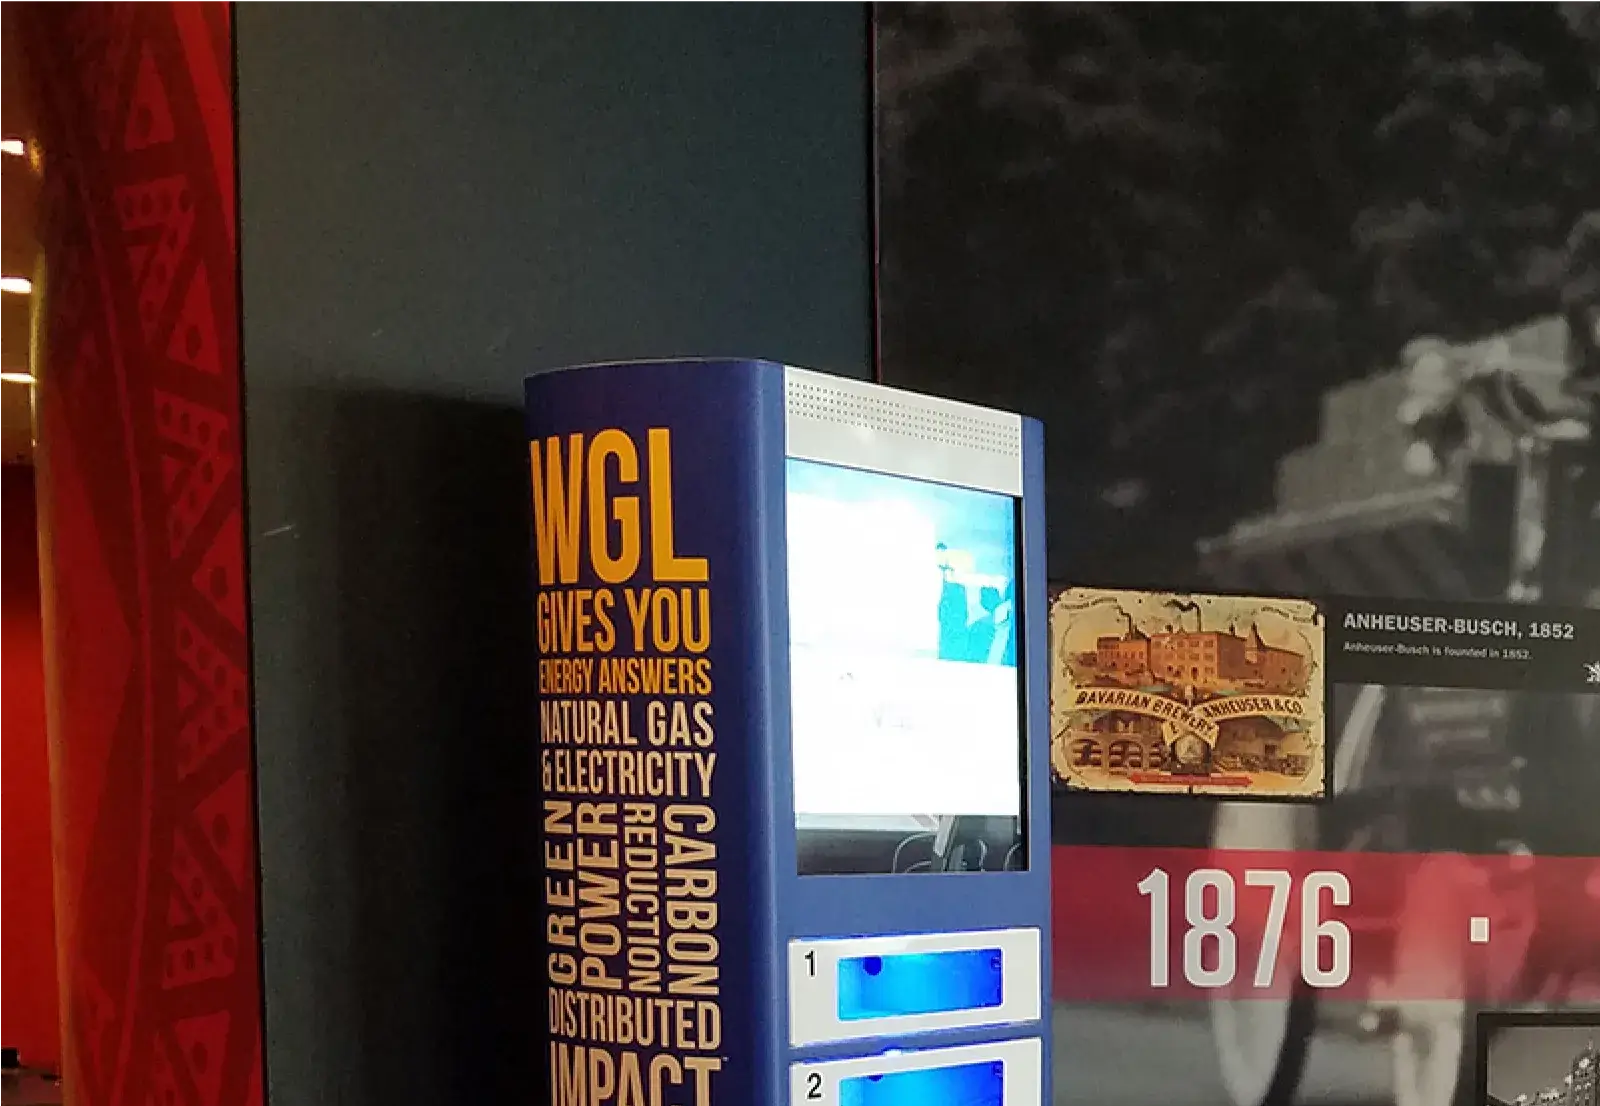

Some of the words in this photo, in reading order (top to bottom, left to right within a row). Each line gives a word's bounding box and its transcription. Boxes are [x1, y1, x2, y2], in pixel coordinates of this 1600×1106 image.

[530, 429, 708, 586] WGL
[538, 588, 616, 653] GIVES
[624, 588, 712, 653] YOU
[1343, 612, 1523, 640] ANHEUSER-BUSCH,
[1529, 621, 1574, 640] 1852
[539, 658, 594, 694] ENERGY
[598, 658, 713, 695] ANSWERS
[1432, 646, 1442, 656] is
[1445, 646, 1488, 659] founded
[540, 700, 639, 745] NATURAL
[647, 700, 714, 747] GAS
[1076, 690, 1150, 708] BAVARIAN
[1152, 699, 1215, 735] BREWERY
[542, 748, 551, 792] &
[554, 749, 717, 797] ELECTRICITY
[544, 800, 578, 985] GREEN
[576, 802, 623, 990] POWER
[623, 802, 662, 993] REDUCTION
[663, 804, 720, 996] CARBON
[1137, 868, 1351, 988] 1876
[804, 951, 816, 977] 1
[549, 987, 721, 1050] DISTRIBUTED
[807, 1073, 823, 1100] 2
